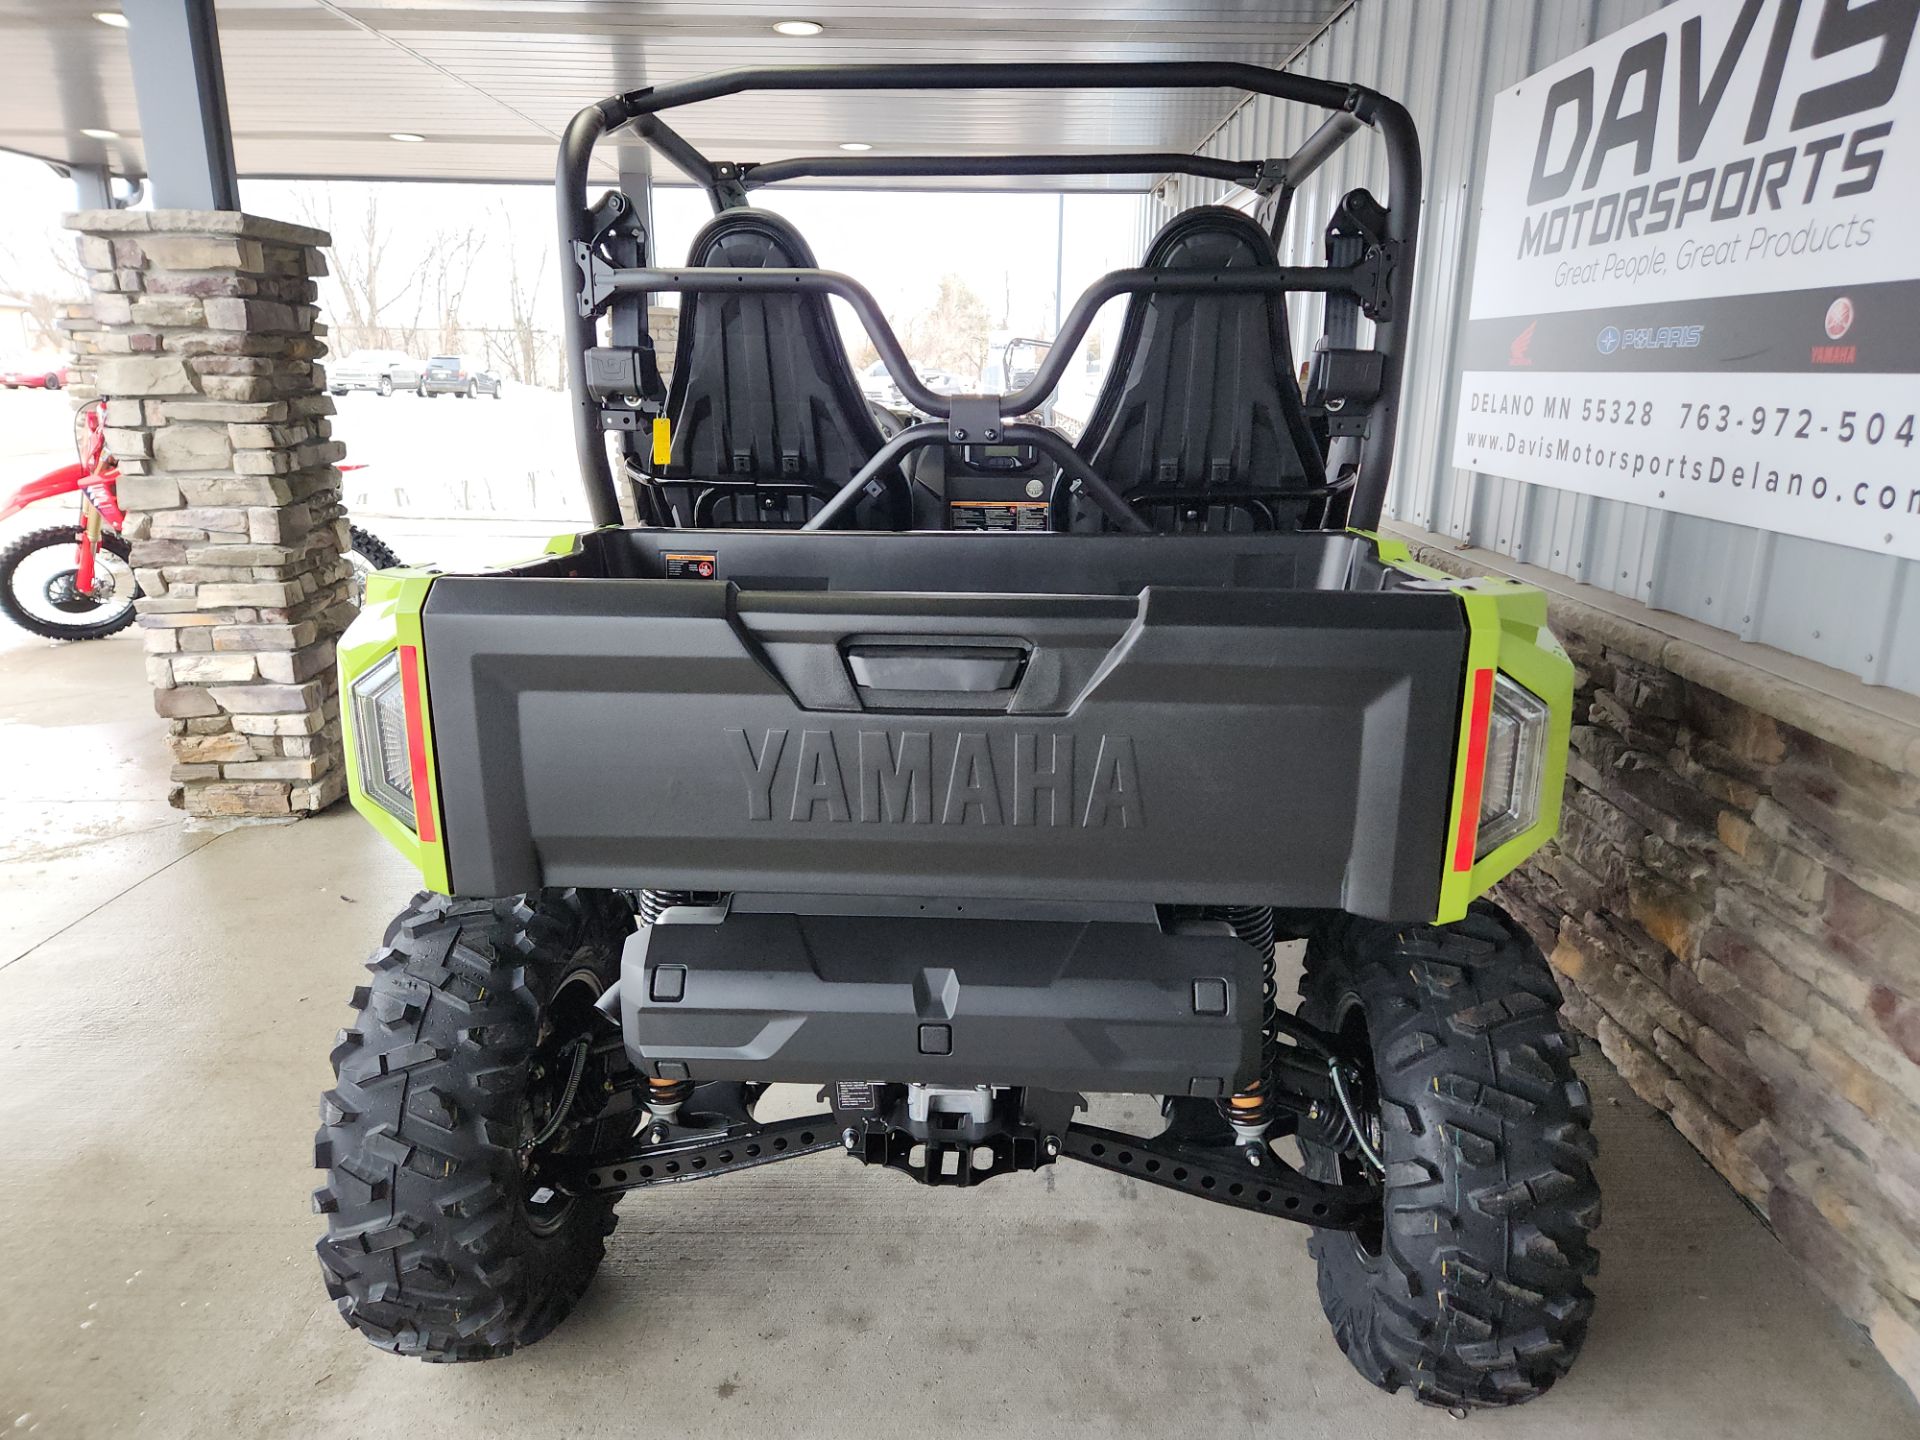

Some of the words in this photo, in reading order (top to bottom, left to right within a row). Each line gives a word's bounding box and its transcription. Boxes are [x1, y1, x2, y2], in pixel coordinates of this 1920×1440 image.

[1527, 0, 1920, 206] DAVIS
[1517, 121, 1894, 260] MOTORSPORTS
[1554, 260, 1599, 288] Great
[1602, 245, 1668, 286] People,
[1676, 238, 1741, 271] Great
[1745, 214, 1876, 261] Products
[1621, 325, 1704, 349] POLARIS
[1811, 345, 1856, 364] YAMAHA
[1471, 393, 1534, 416] DELANO
[1544, 397, 1571, 420] MN
[1582, 398, 1653, 427] 55328
[1680, 403, 1915, 448] 763-972-504
[723, 728, 1146, 829] YAMAHA
